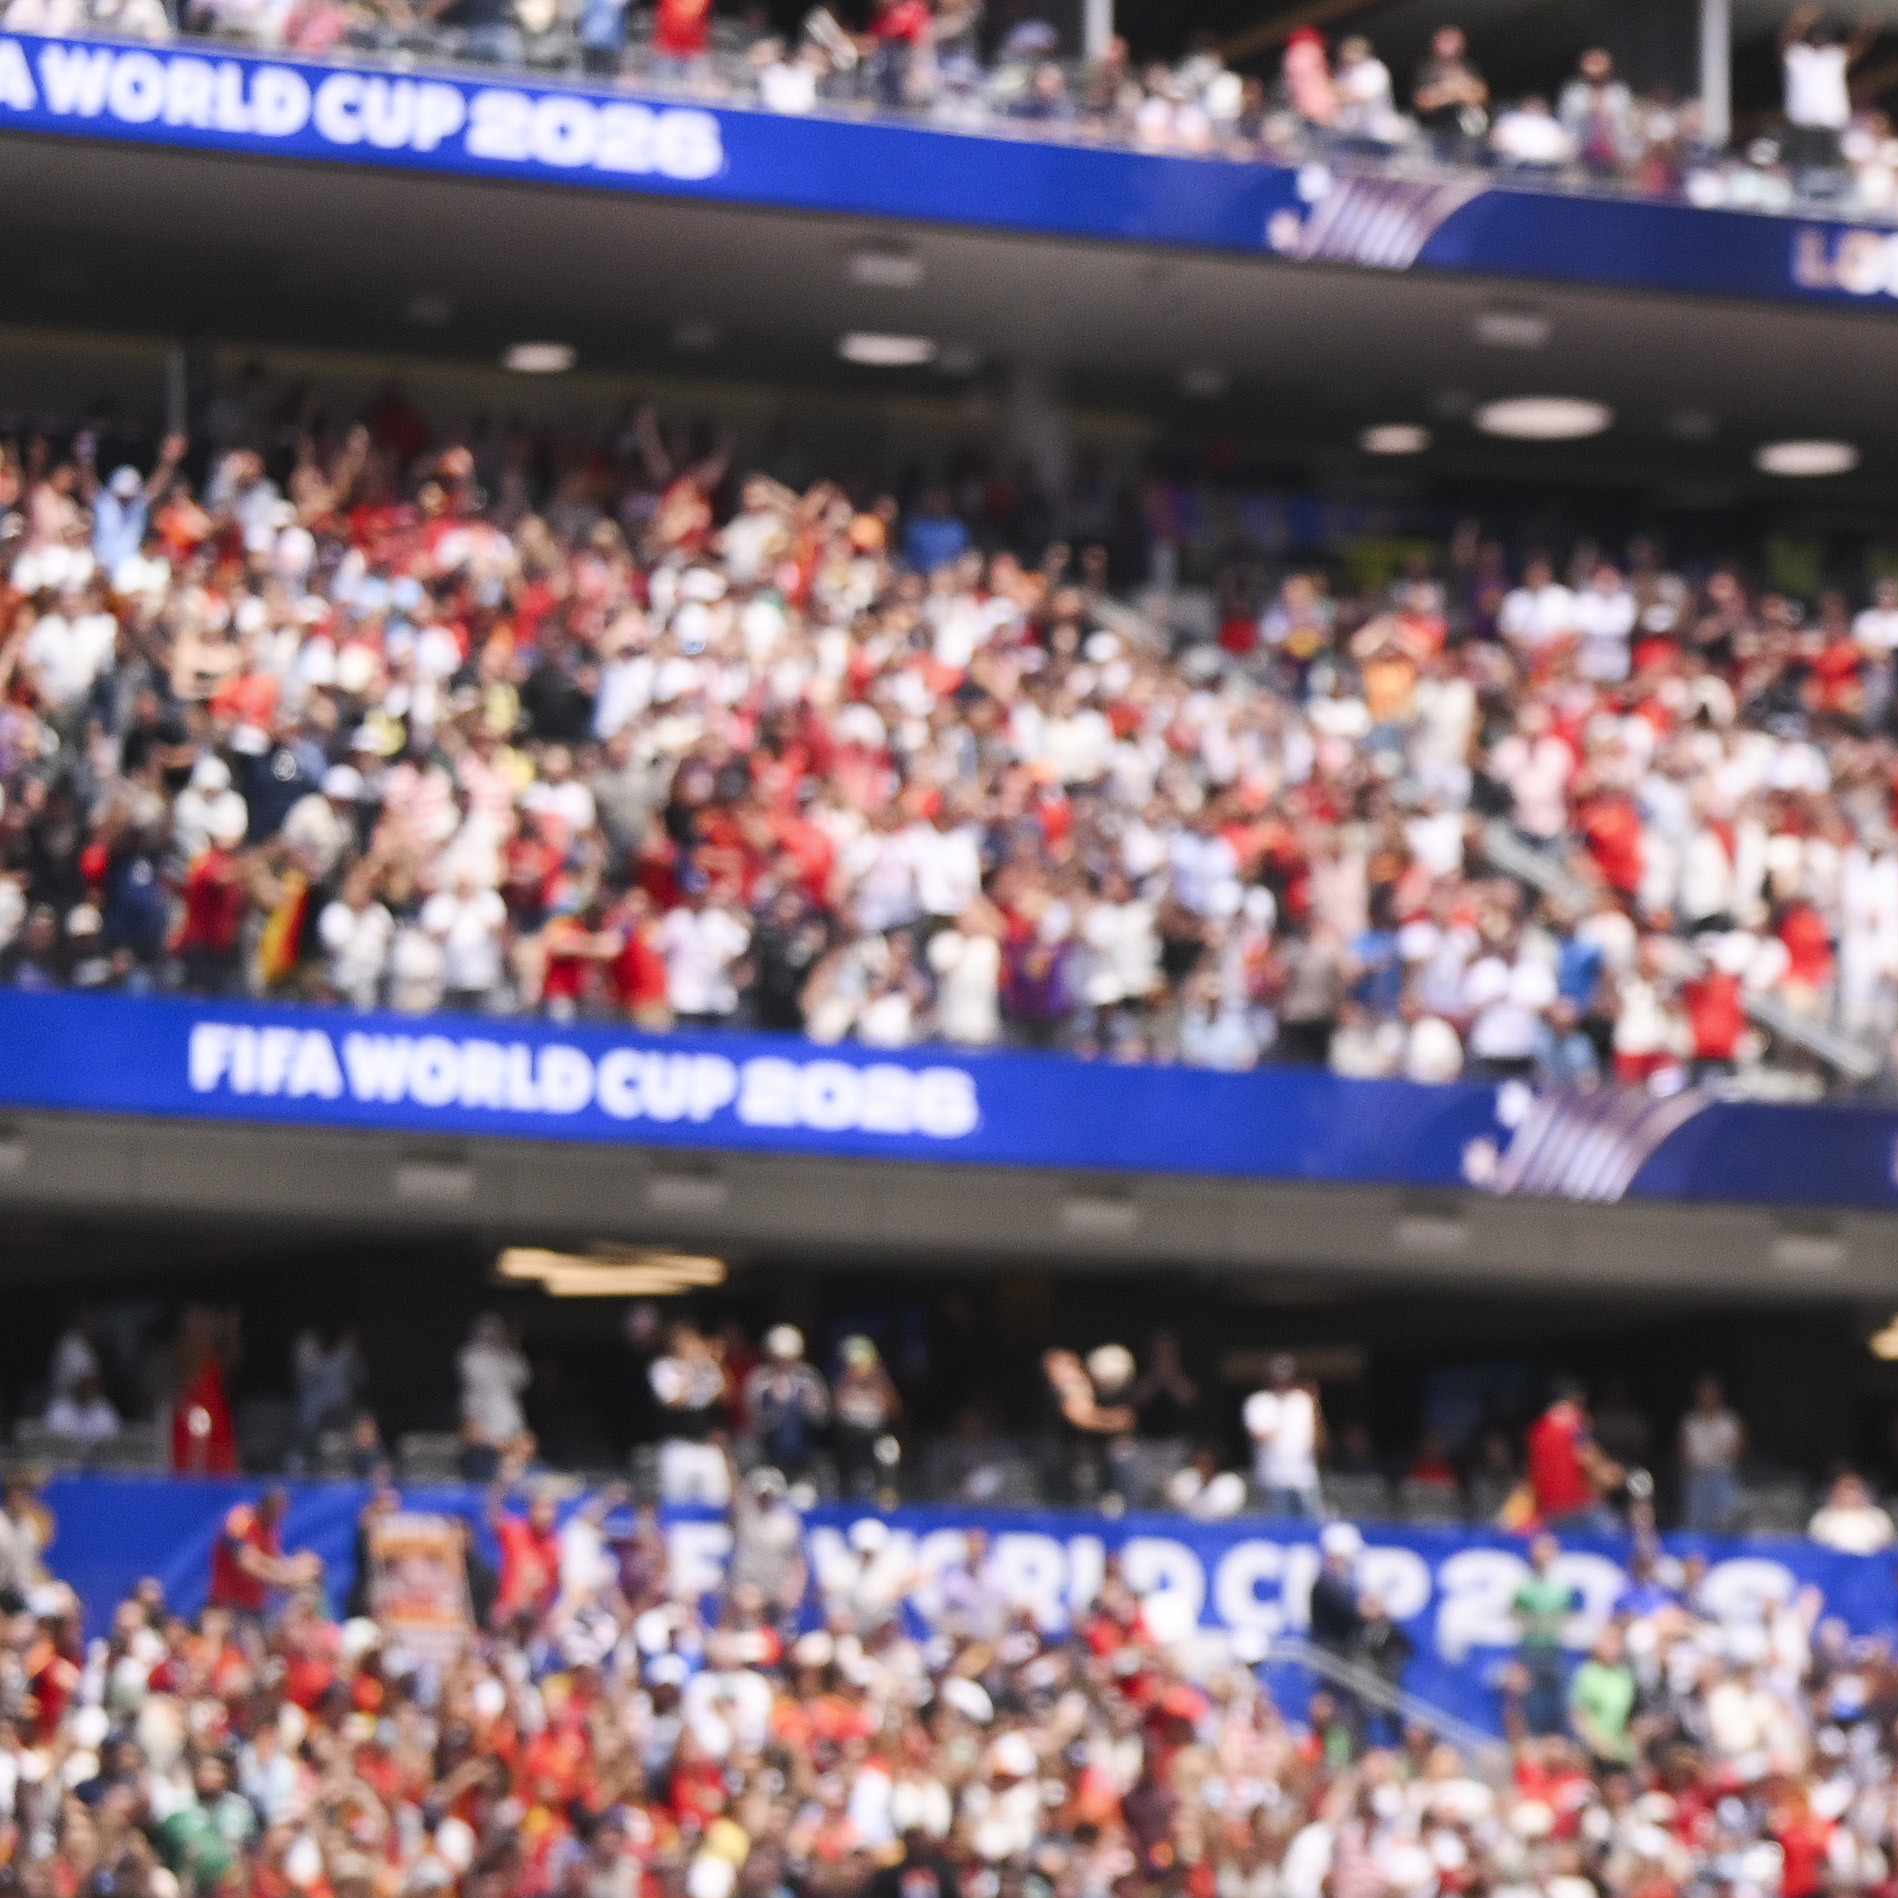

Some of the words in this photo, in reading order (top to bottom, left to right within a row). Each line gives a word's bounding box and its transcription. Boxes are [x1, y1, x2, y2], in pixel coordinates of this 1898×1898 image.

[37, 42, 311, 138] WORLD
[312, 70, 466, 151] CUP
[466, 88, 726, 182] 2026
[188, 1021, 345, 1100] FIFA
[342, 1030, 596, 1115] WORLD
[596, 1047, 738, 1123] CUP
[736, 1056, 979, 1138] 2026
